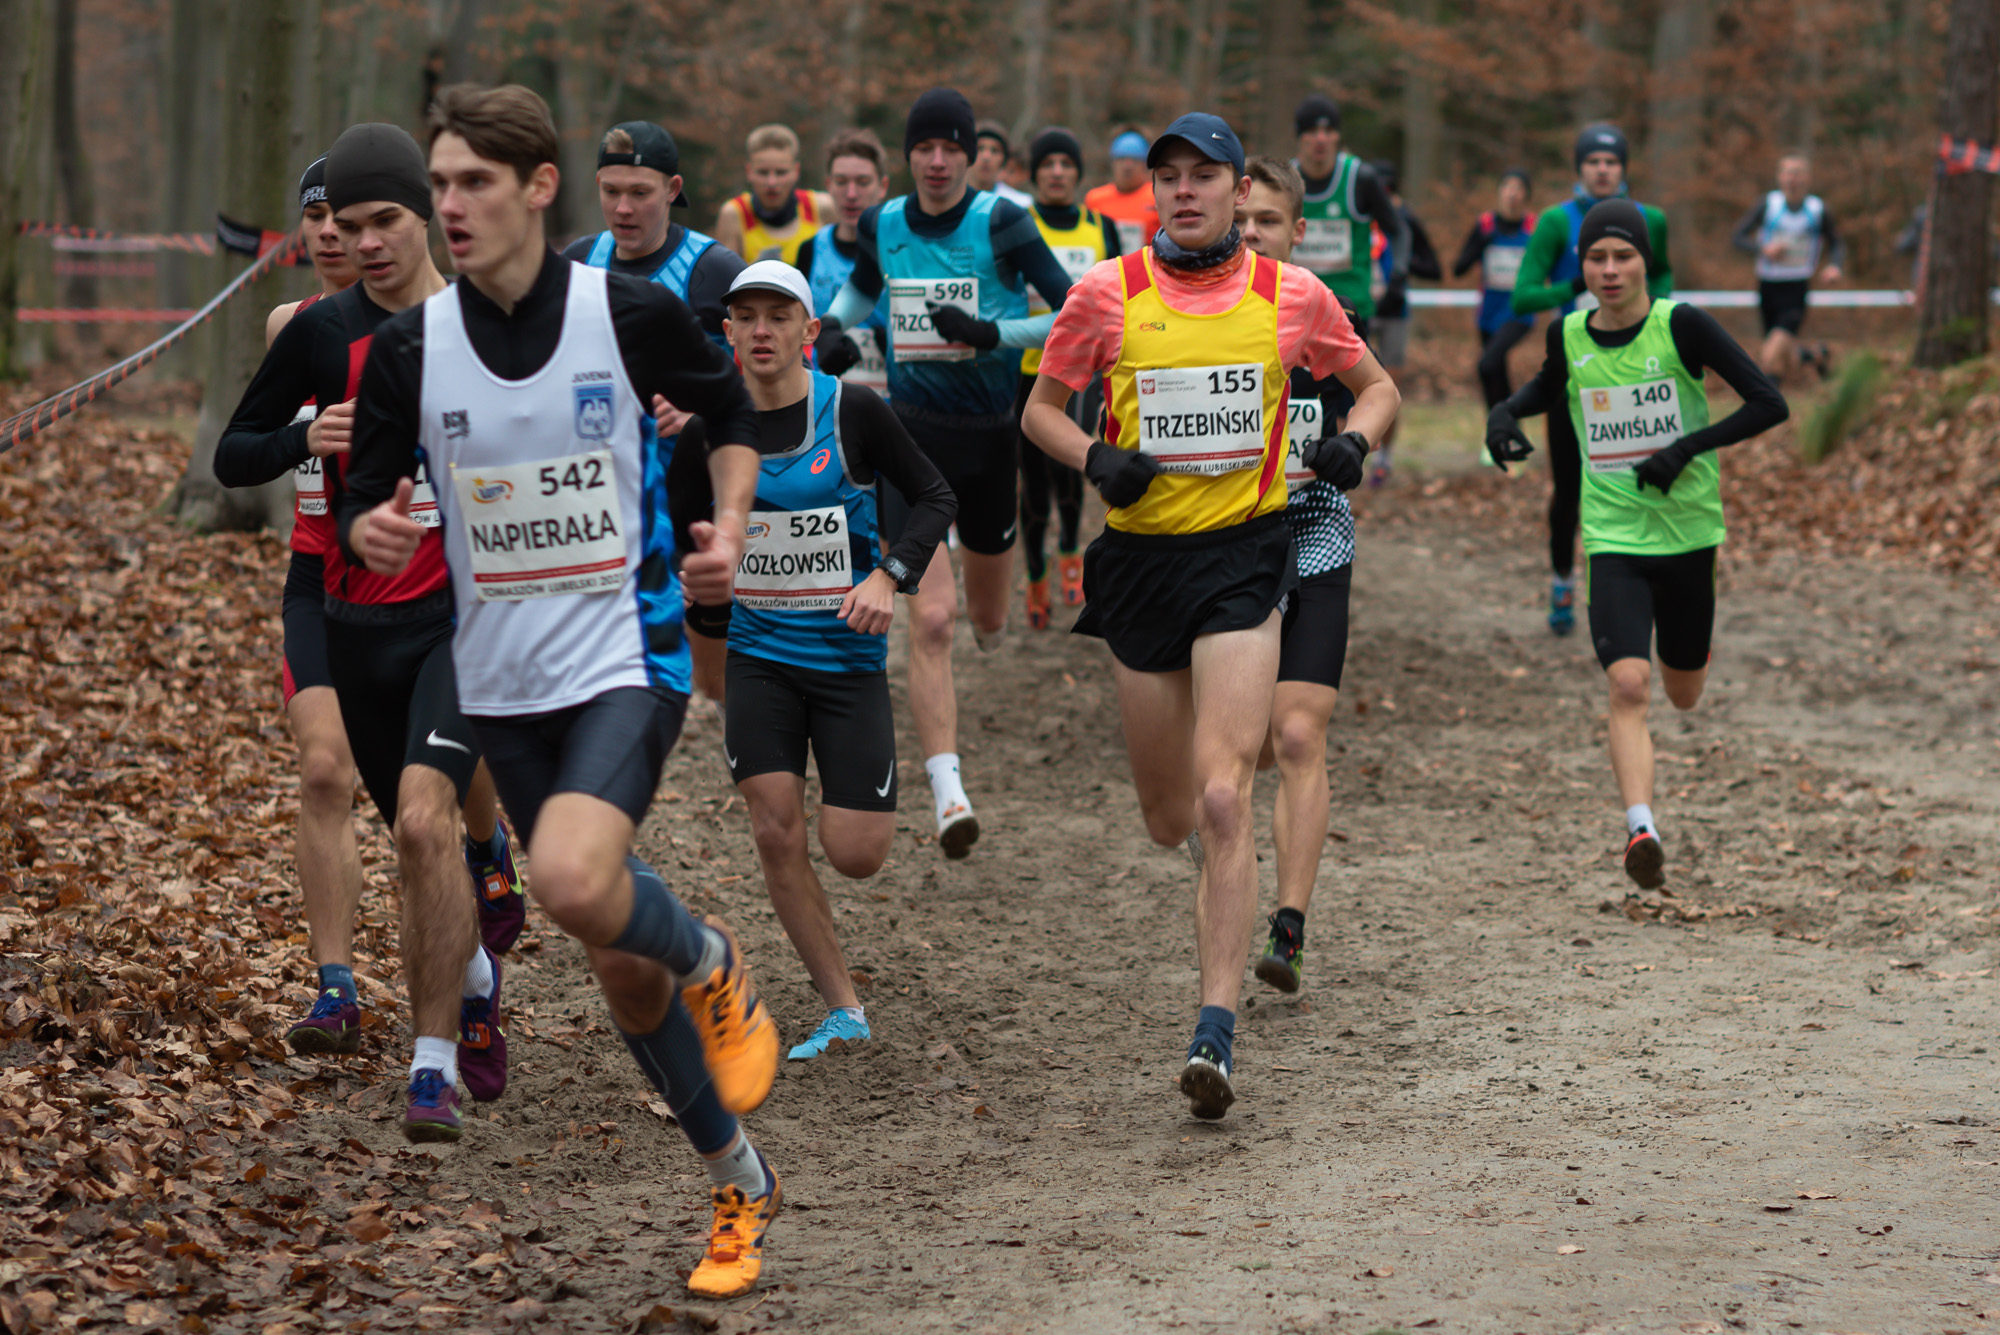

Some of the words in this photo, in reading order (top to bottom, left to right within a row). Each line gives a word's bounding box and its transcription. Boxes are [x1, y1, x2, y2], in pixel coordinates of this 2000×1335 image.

[934, 283, 973, 300] 598
[1207, 368, 1257, 395] 155
[1632, 383, 1671, 407] 140
[1143, 406, 1260, 439] TRZEBIŃSKI
[1288, 403, 1316, 424] 70
[1589, 414, 1678, 442] ZAWIŚLAK
[539, 459, 605, 496] 542
[1203, 461, 1240, 473] LUBELSKI
[470, 510, 618, 553] NAPIERAŁA
[790, 512, 839, 538] 526
[737, 549, 845, 576] KOZŁOWSKI
[548, 577, 597, 593] LUBELSKI
[739, 597, 788, 607] TOMASZÓW
[790, 598, 827, 608] LUBELSKI
[829, 597, 844, 606] 202
